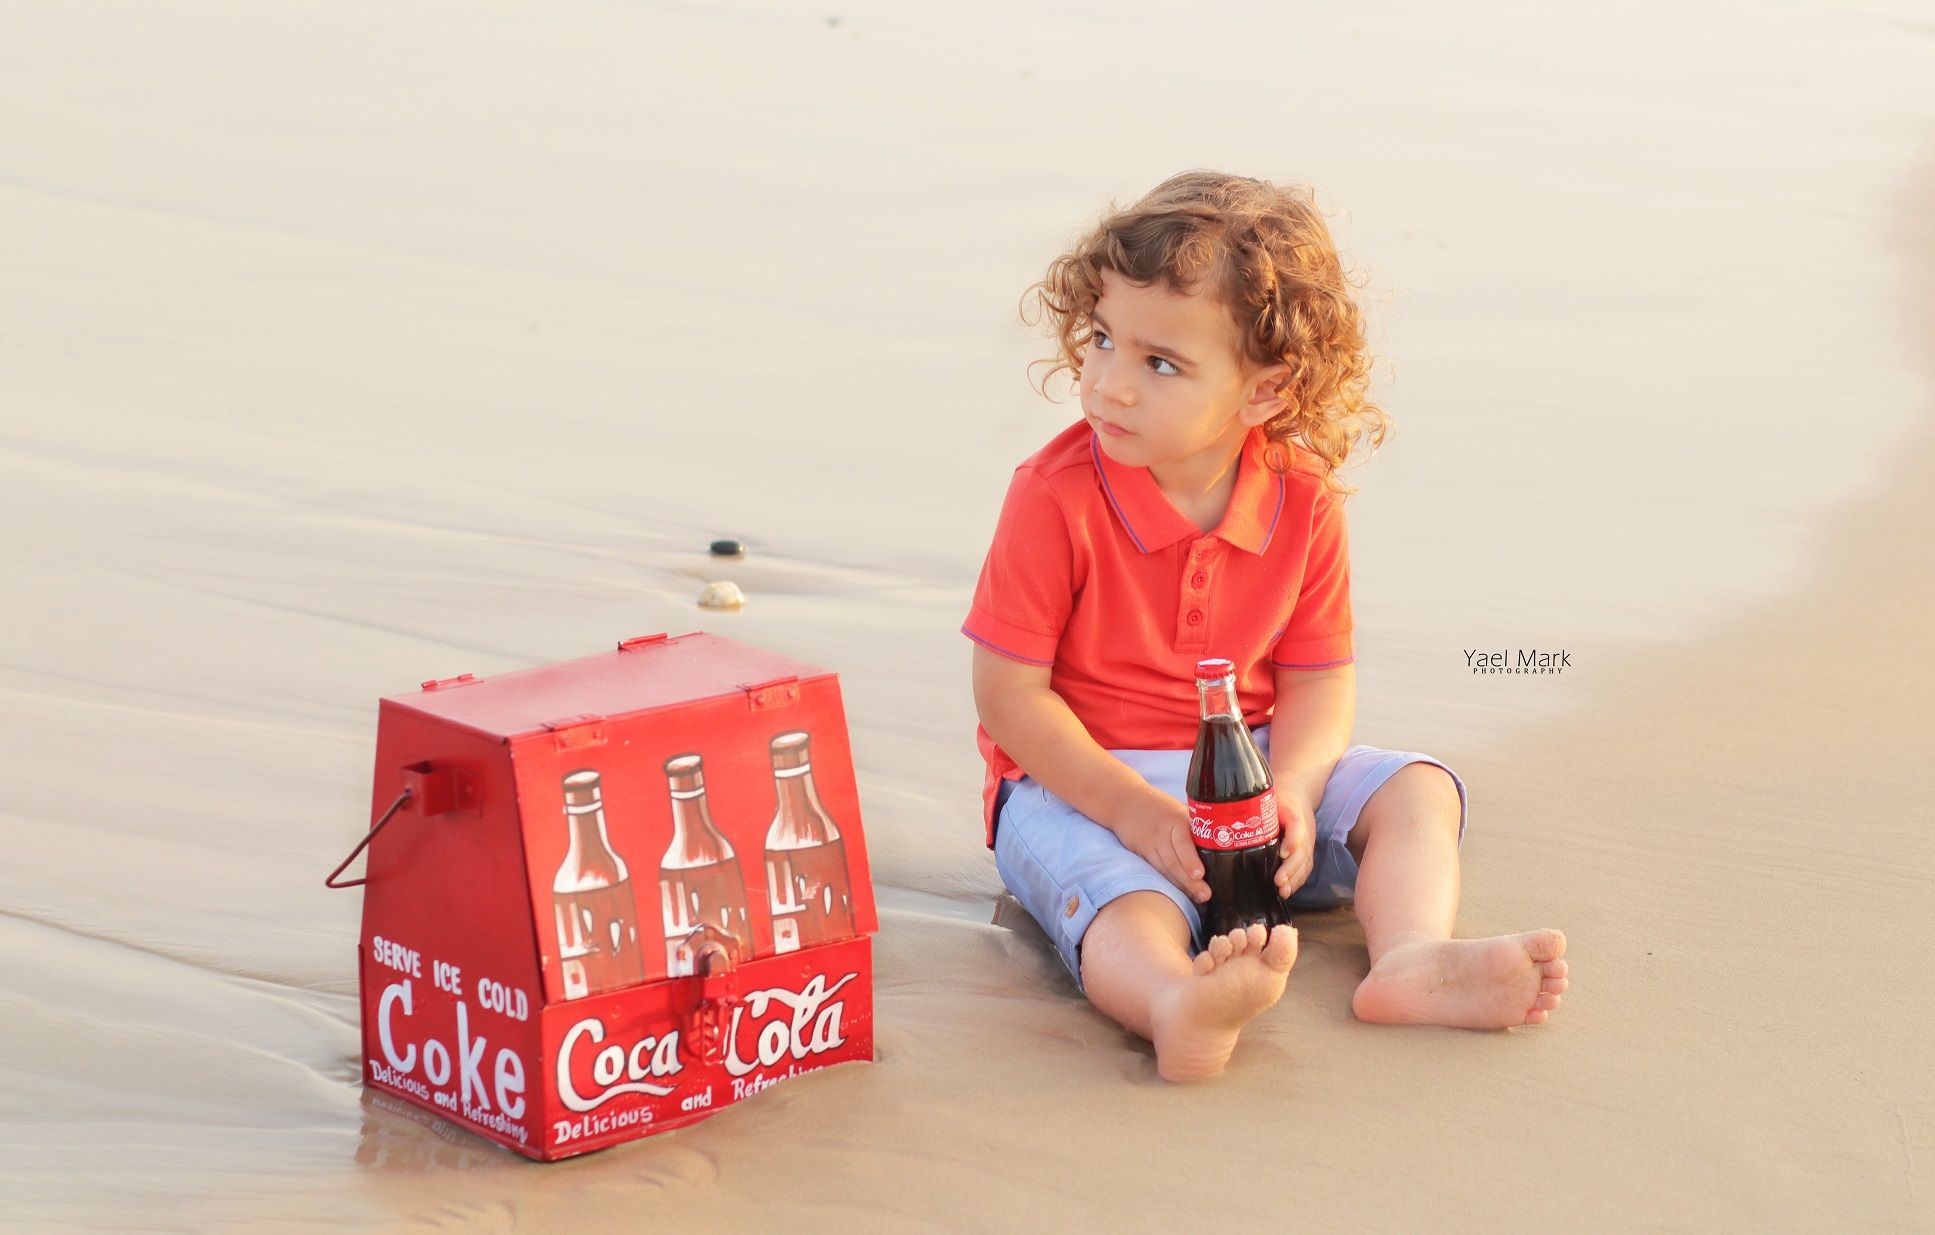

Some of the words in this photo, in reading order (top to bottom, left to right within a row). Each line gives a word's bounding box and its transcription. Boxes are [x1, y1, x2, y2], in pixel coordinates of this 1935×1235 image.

[1192, 816, 1215, 839] Cola
[373, 935, 421, 978] SERVE
[433, 960, 462, 995] ICE
[478, 978, 528, 1021] COLD
[378, 979, 525, 1119] Coke
[557, 1017, 684, 1112] Coca
[723, 972, 858, 1077] Cola
[369, 1059, 429, 1100] Delicious
[434, 1091, 458, 1112] and
[463, 1097, 528, 1147] Refreshing
[554, 1106, 653, 1144] Delicious
[681, 1086, 712, 1111] and
